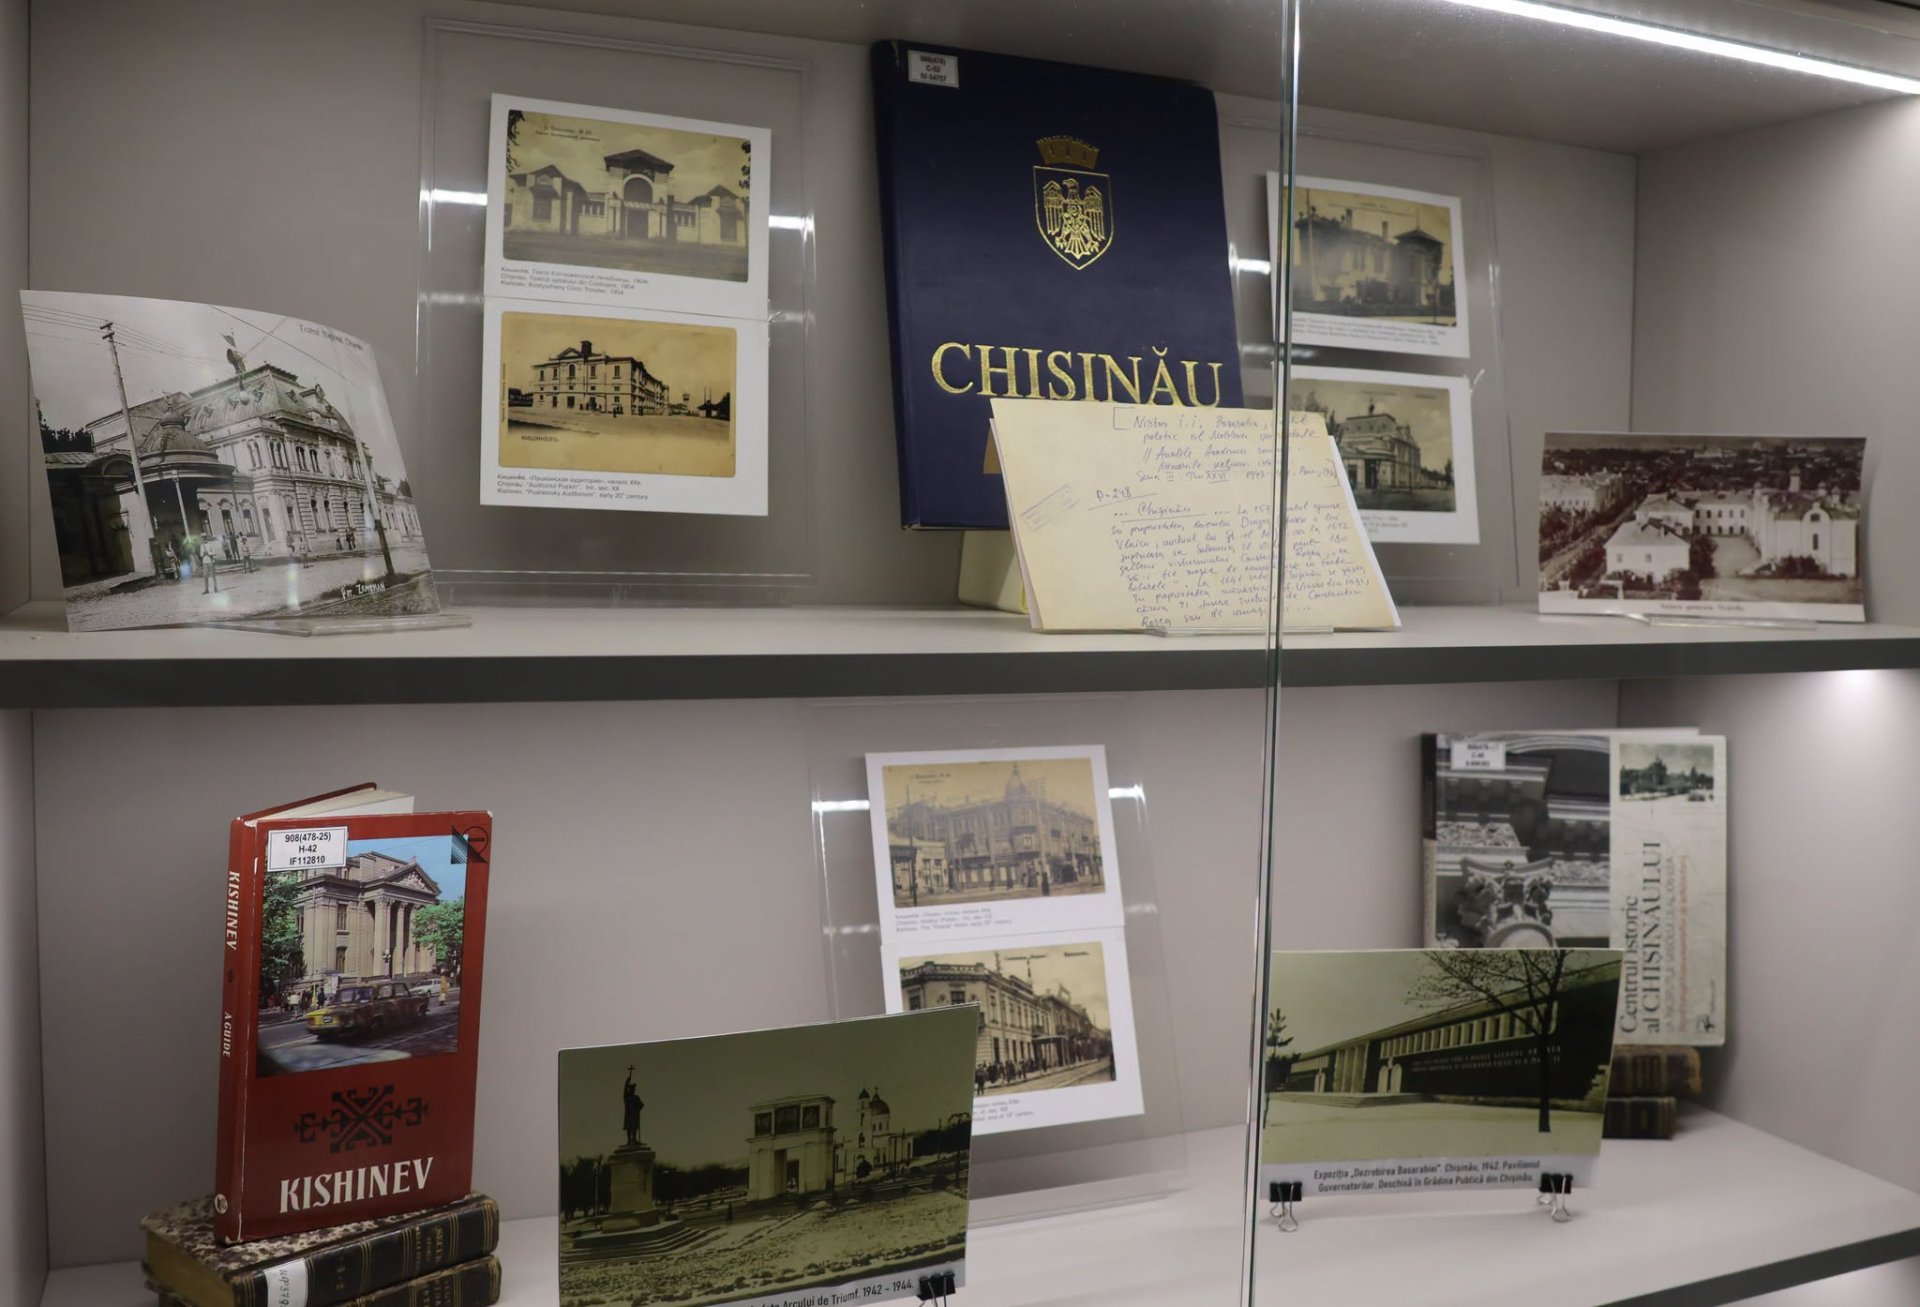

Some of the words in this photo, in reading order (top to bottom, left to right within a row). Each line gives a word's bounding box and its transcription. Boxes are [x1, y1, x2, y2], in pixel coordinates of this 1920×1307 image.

[285, 831, 331, 843] 908(478-25)
[298, 844, 317, 853] H-42
[289, 855, 326, 866] IF112810
[226, 870, 241, 951] KISHINEV
[1622, 895, 1639, 955] istoric
[1619, 959, 1638, 1034] Centrul
[224, 1011, 232, 1020] A
[1643, 1018, 1660, 1034] al
[222, 1021, 232, 1059] GUIDE
[279, 1156, 434, 1214] KISHINEV
[817, 1295, 829, 1306] de
[831, 1289, 861, 1305] Triumf.
[863, 1284, 882, 1297] 1942
